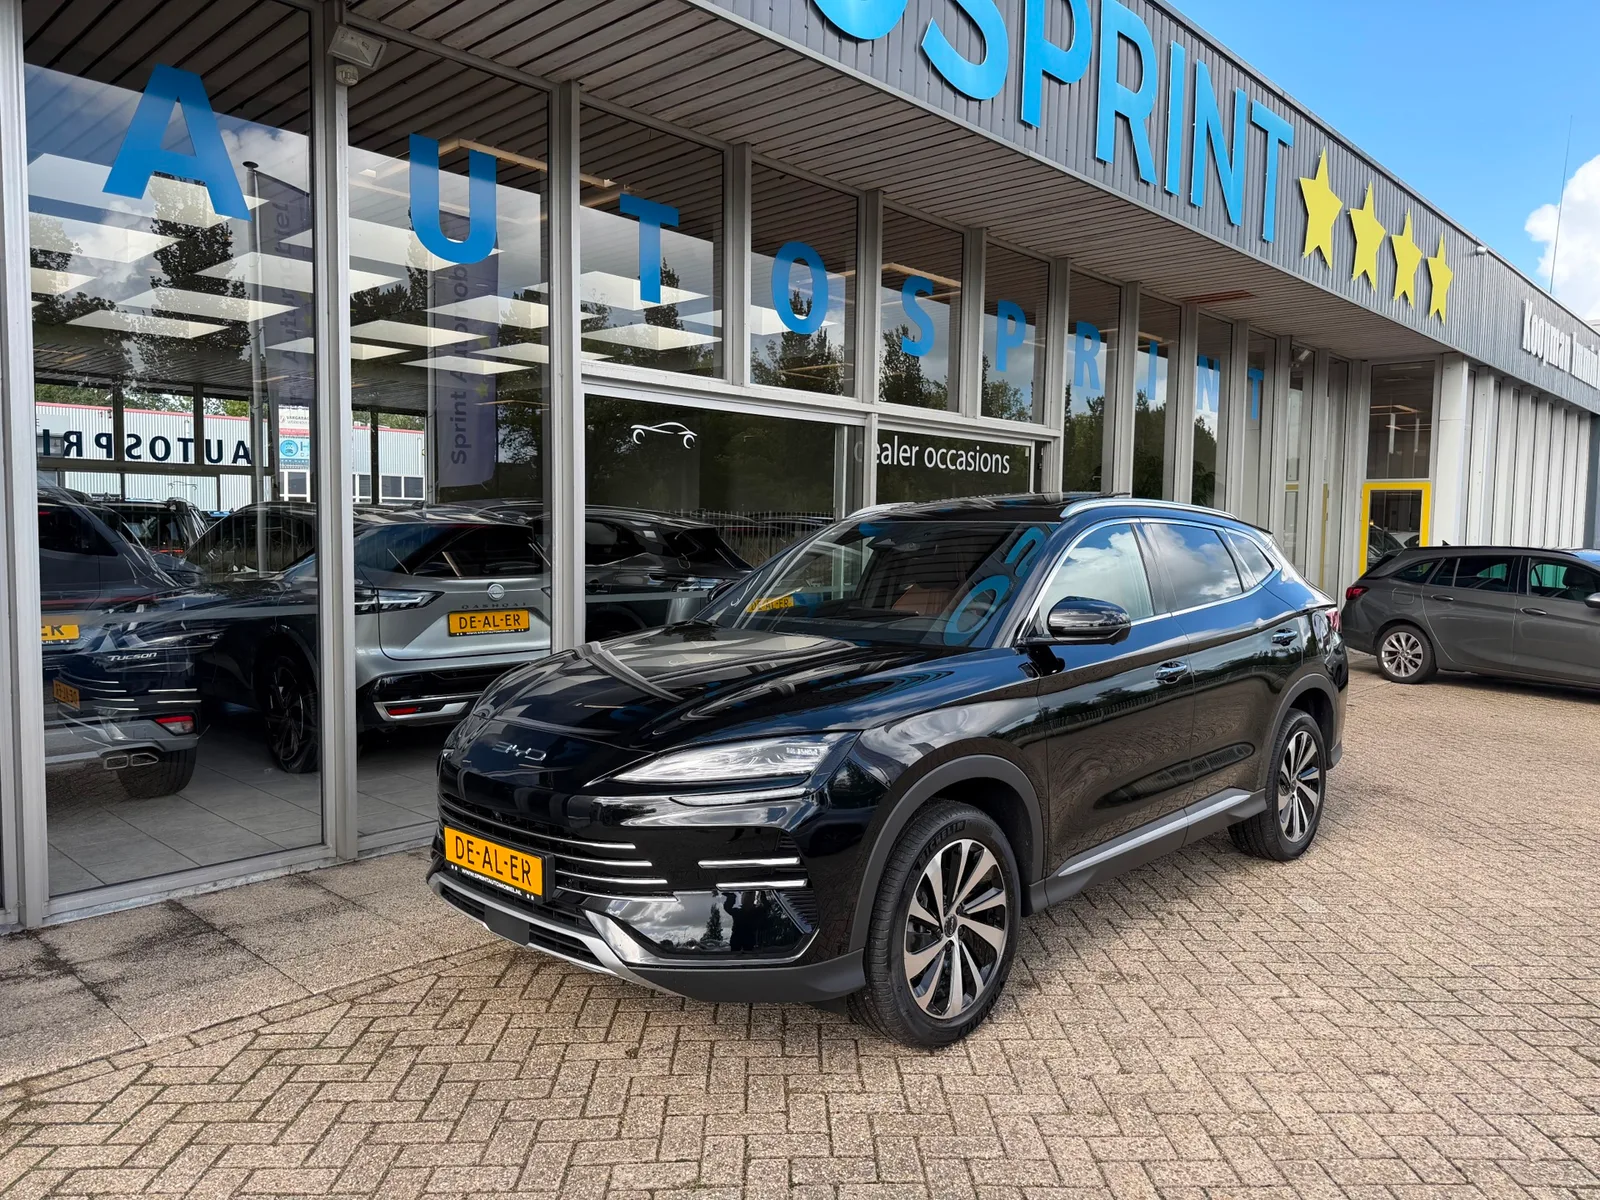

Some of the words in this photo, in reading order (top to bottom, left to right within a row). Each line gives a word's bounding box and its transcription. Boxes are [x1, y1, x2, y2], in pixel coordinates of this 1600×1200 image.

[450, 391, 472, 464] Sprint
[924, 445, 1010, 474] occasions
[461, 602, 526, 610] QASHQAI
[458, 613, 522, 630] DE-AL-ER
[492, 741, 547, 761] BYD
[455, 835, 532, 887] DE-AL-ER
